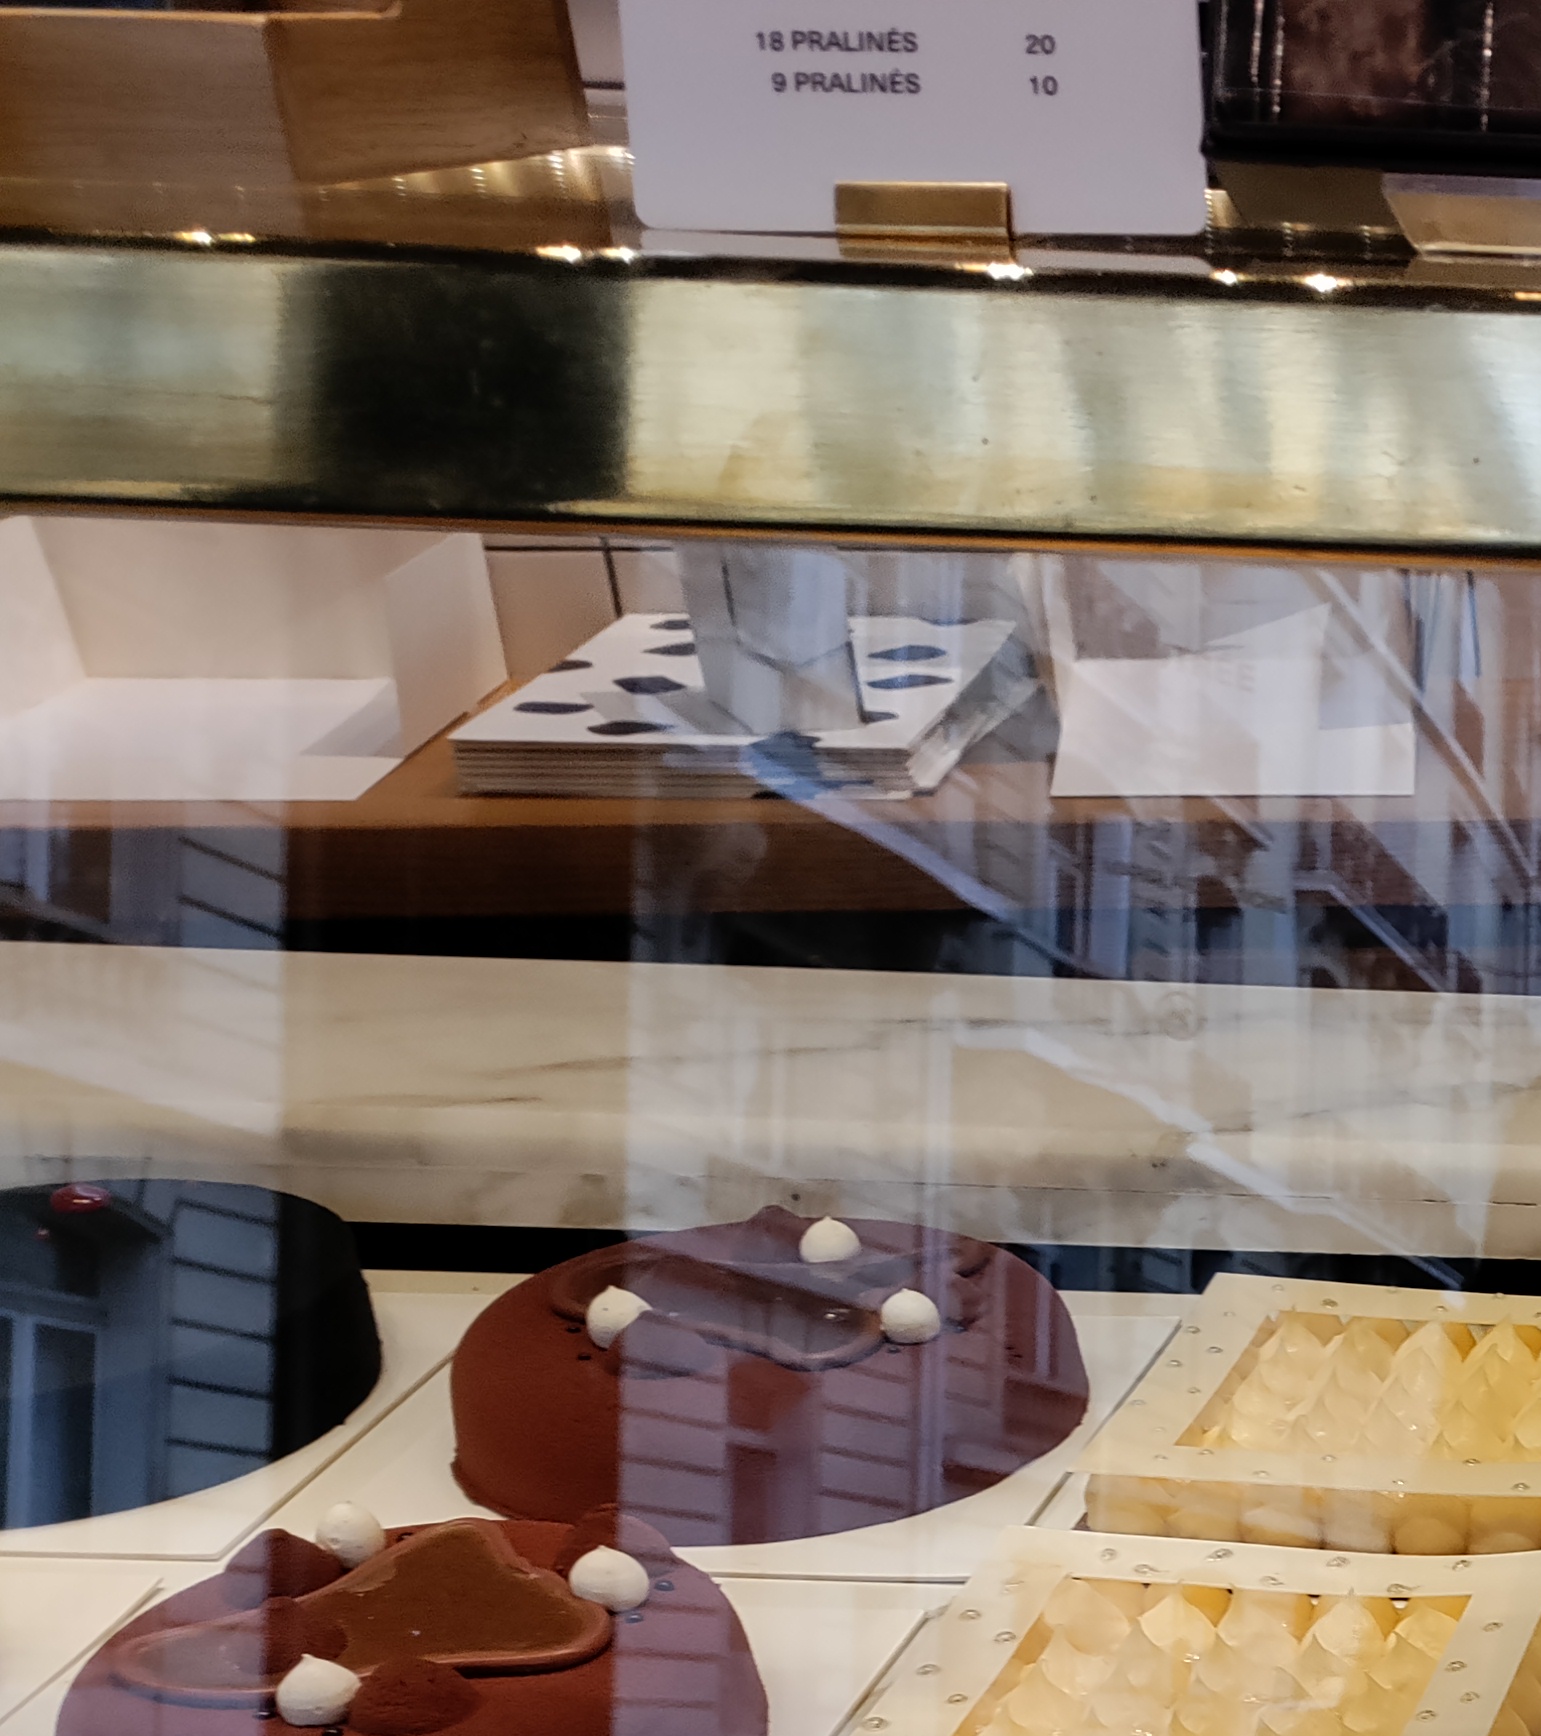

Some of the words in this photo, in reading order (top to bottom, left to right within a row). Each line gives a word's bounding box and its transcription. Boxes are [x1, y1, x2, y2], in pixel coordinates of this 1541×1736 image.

[756, 31, 784, 52] 18
[791, 27, 918, 53] PRALINÉS
[1026, 34, 1055, 55] 20
[772, 73, 787, 92] 9
[794, 69, 920, 94] PRALINÉS
[1030, 76, 1058, 96] 10
